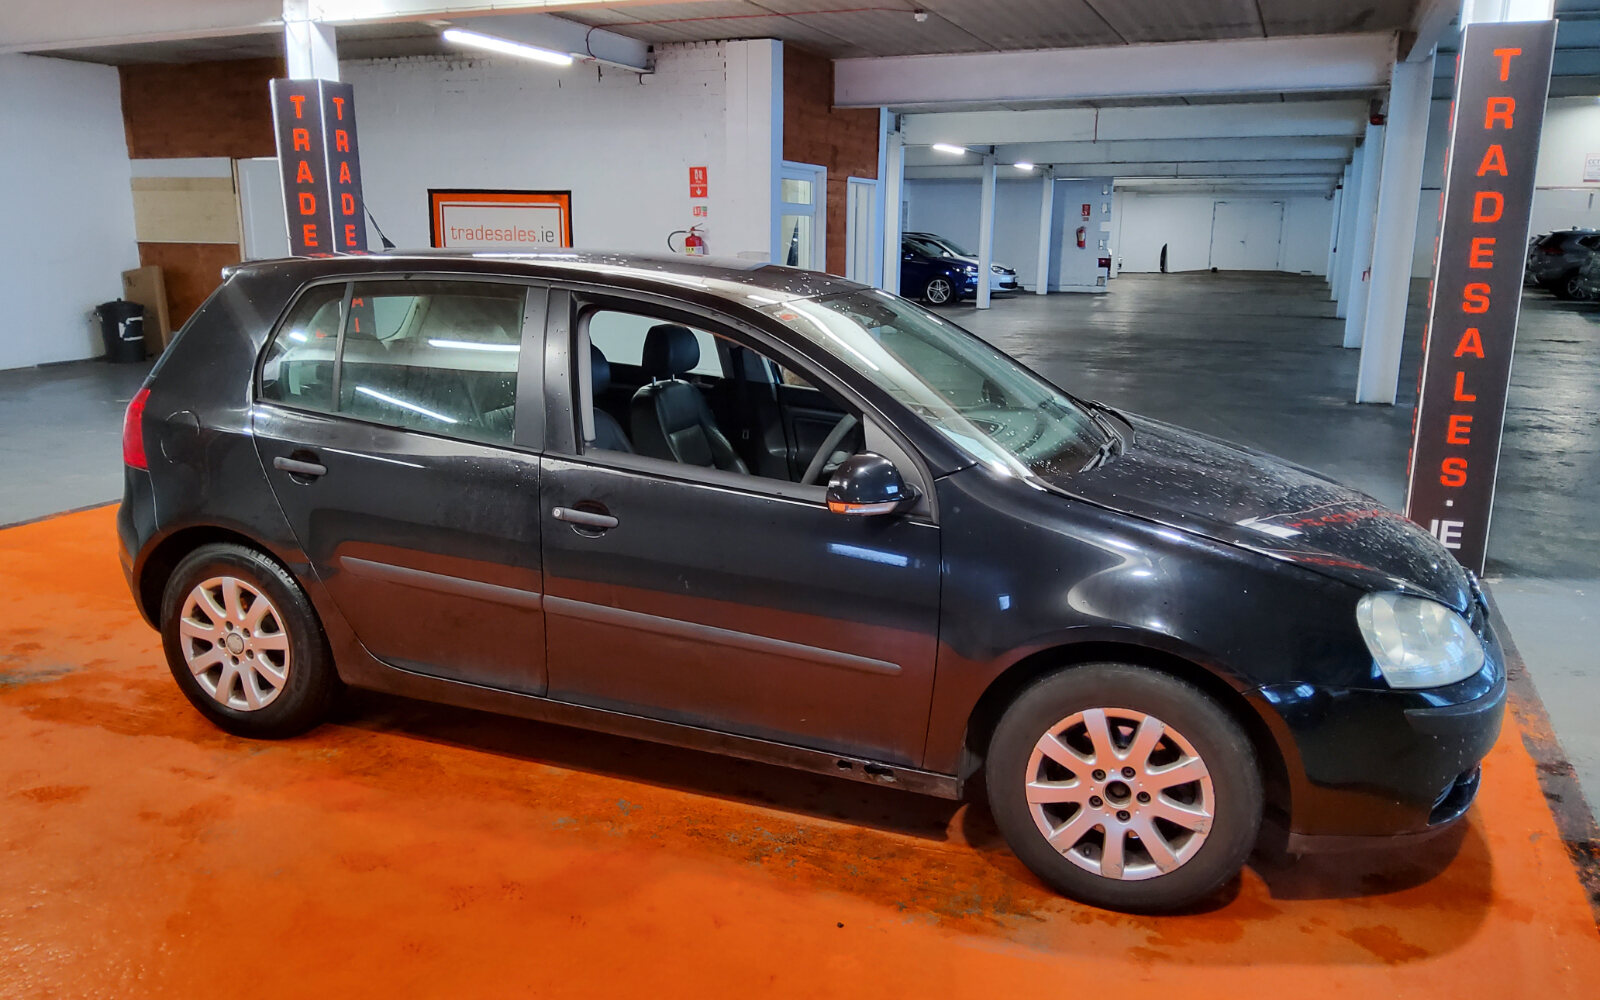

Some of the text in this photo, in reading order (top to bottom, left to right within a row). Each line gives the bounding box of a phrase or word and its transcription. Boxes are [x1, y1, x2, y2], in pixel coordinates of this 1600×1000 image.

[289, 95, 318, 247] TRADE
[332, 97, 357, 247] TRADE
[450, 225, 555, 243] tradesales.ie
